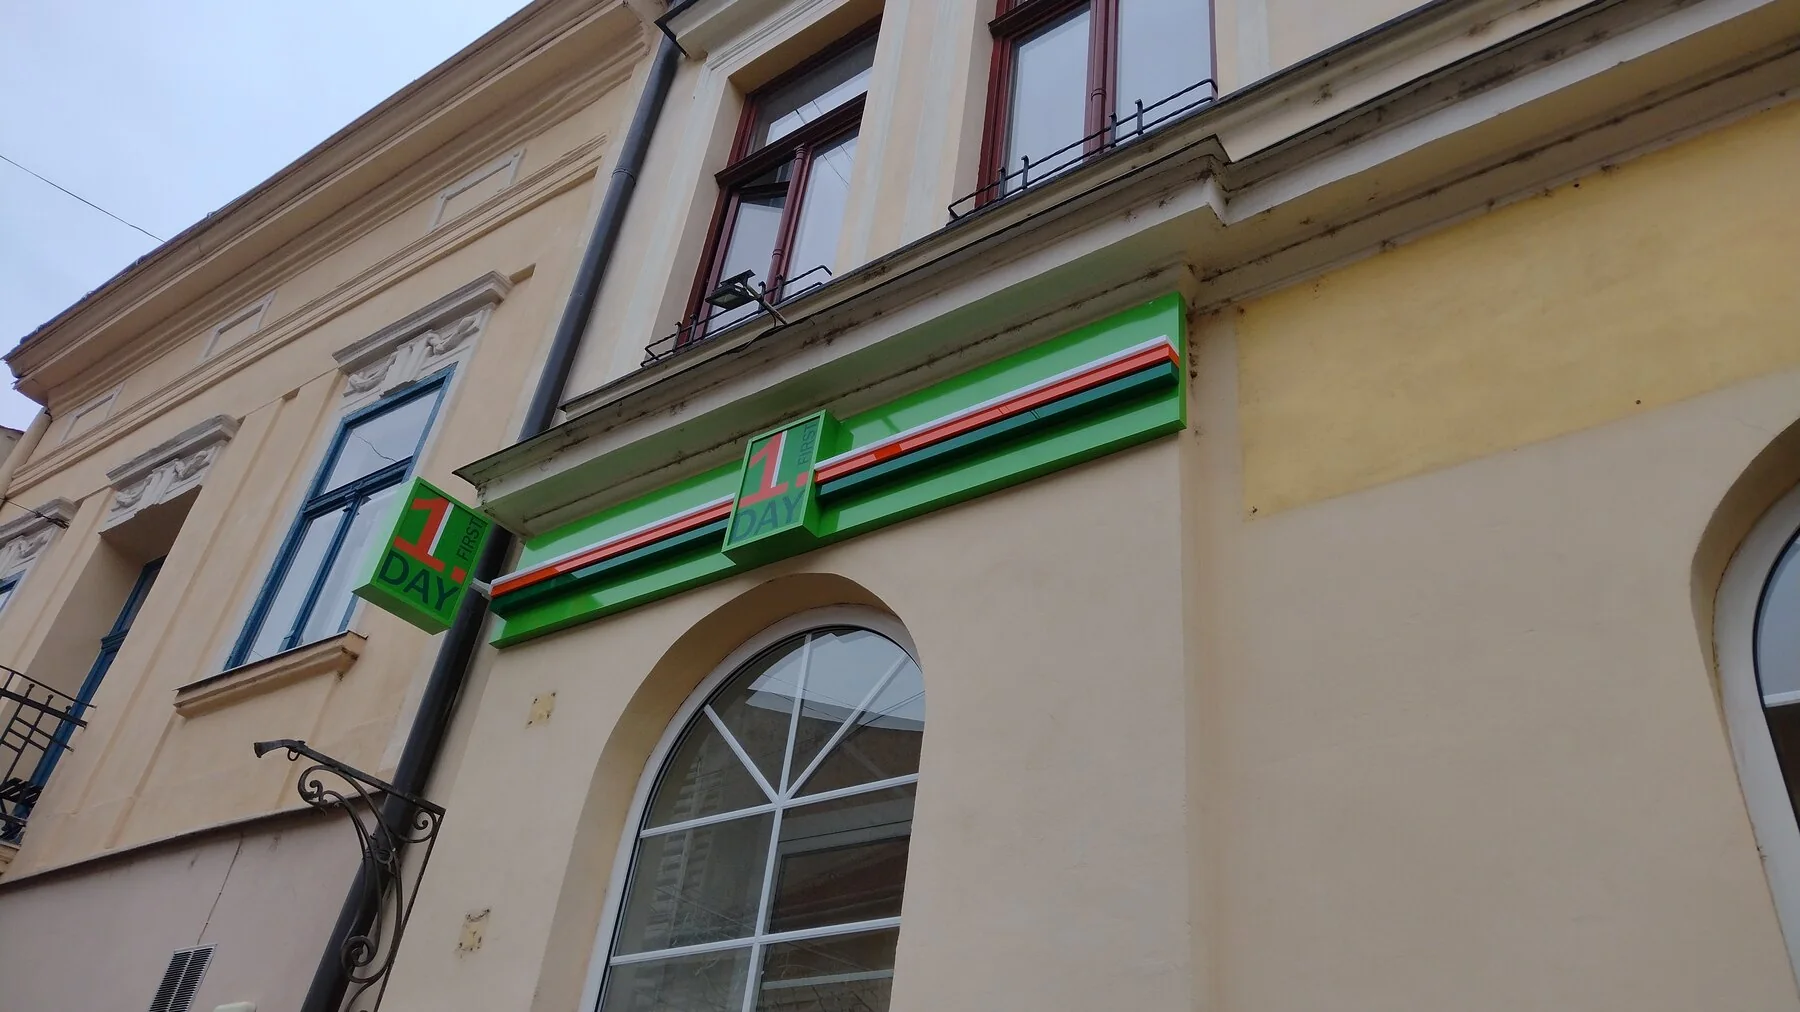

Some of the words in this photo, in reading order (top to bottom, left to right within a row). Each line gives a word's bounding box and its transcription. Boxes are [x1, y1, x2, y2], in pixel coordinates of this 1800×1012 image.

[798, 422, 817, 466] FIRST
[456, 517, 485, 562] FIRST
[730, 490, 806, 543] DAY
[378, 550, 460, 612] DAY
